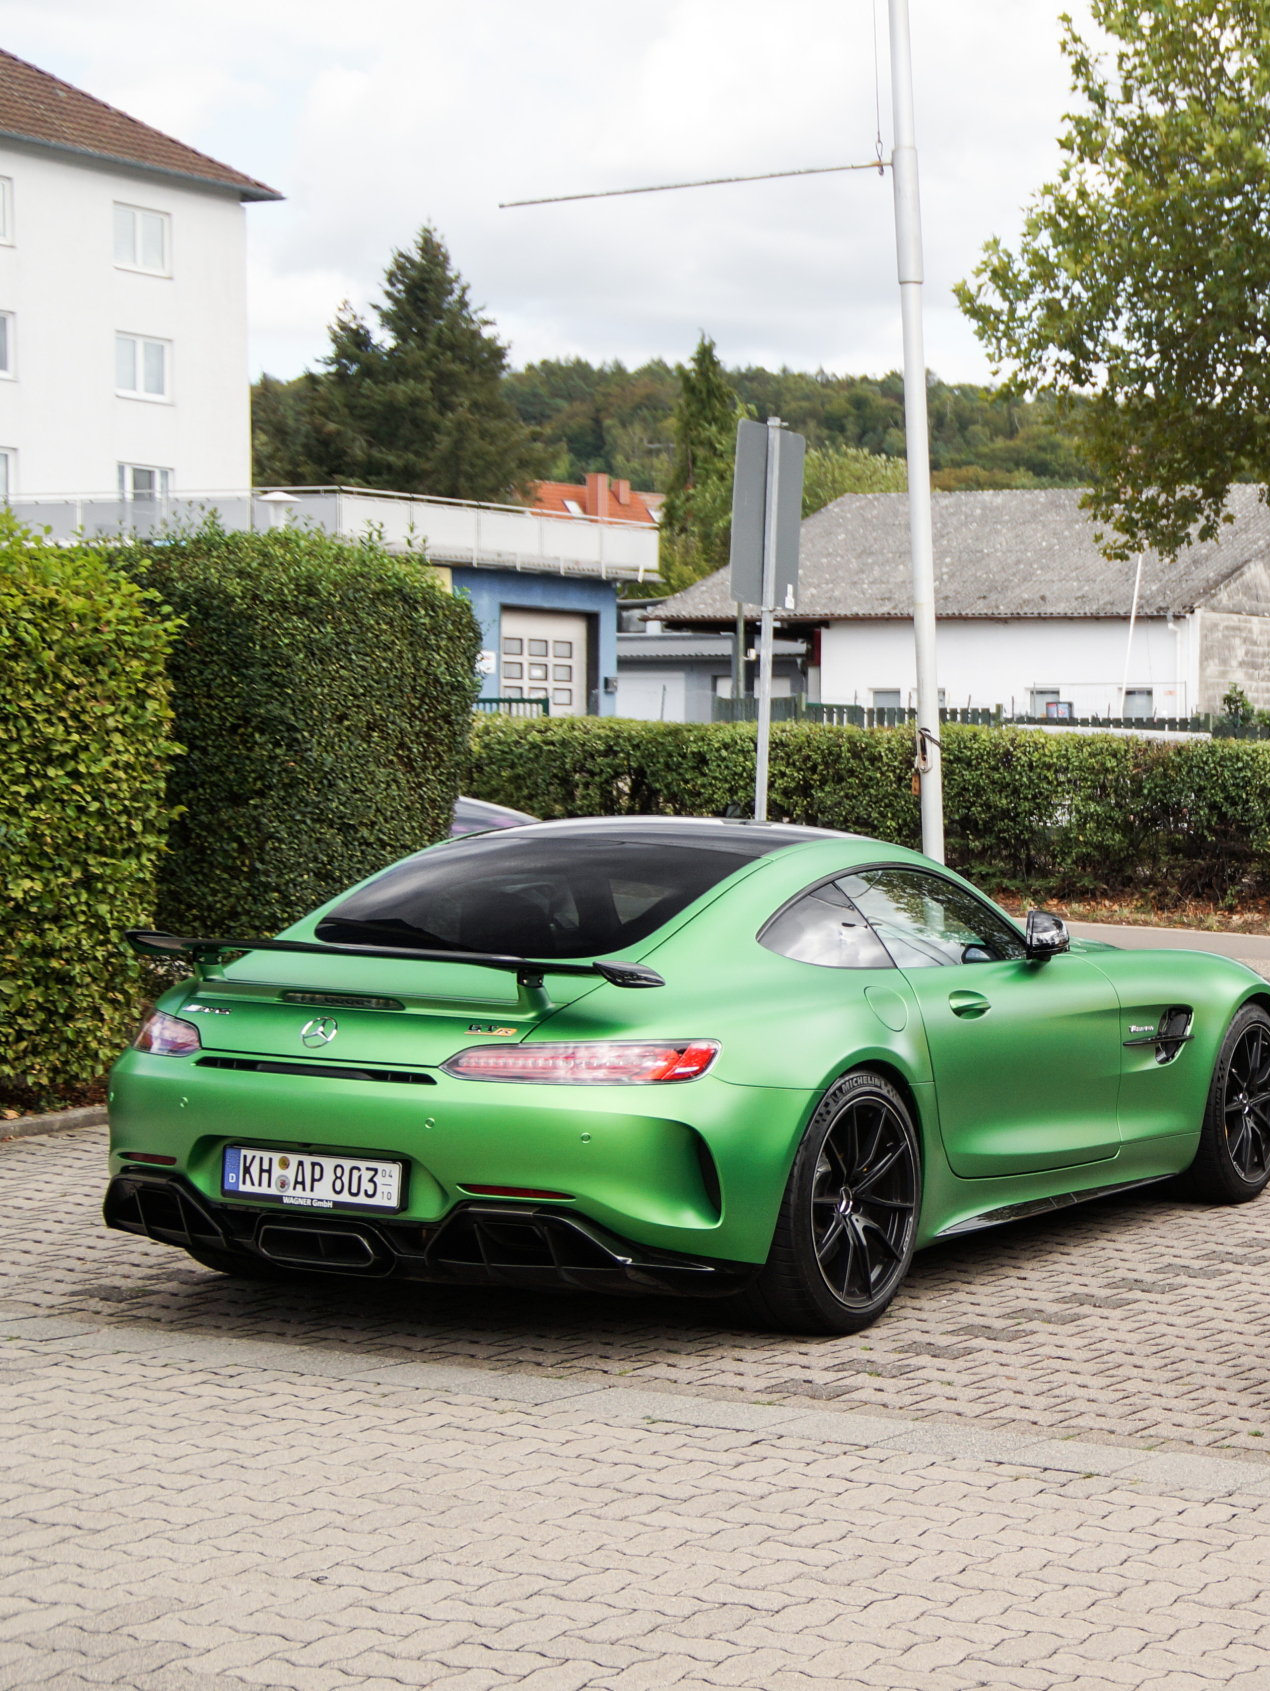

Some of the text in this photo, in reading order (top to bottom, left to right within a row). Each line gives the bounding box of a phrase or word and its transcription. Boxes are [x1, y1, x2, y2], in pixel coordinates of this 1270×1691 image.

[841, 1076, 881, 1094] MICHELIN
[228, 1172, 237, 1183] D
[242, 1154, 379, 1198] KH AP 803
[381, 1168, 393, 1178] 04
[381, 1190, 392, 1201] 10
[282, 1196, 333, 1209] WAGNER GmbH
